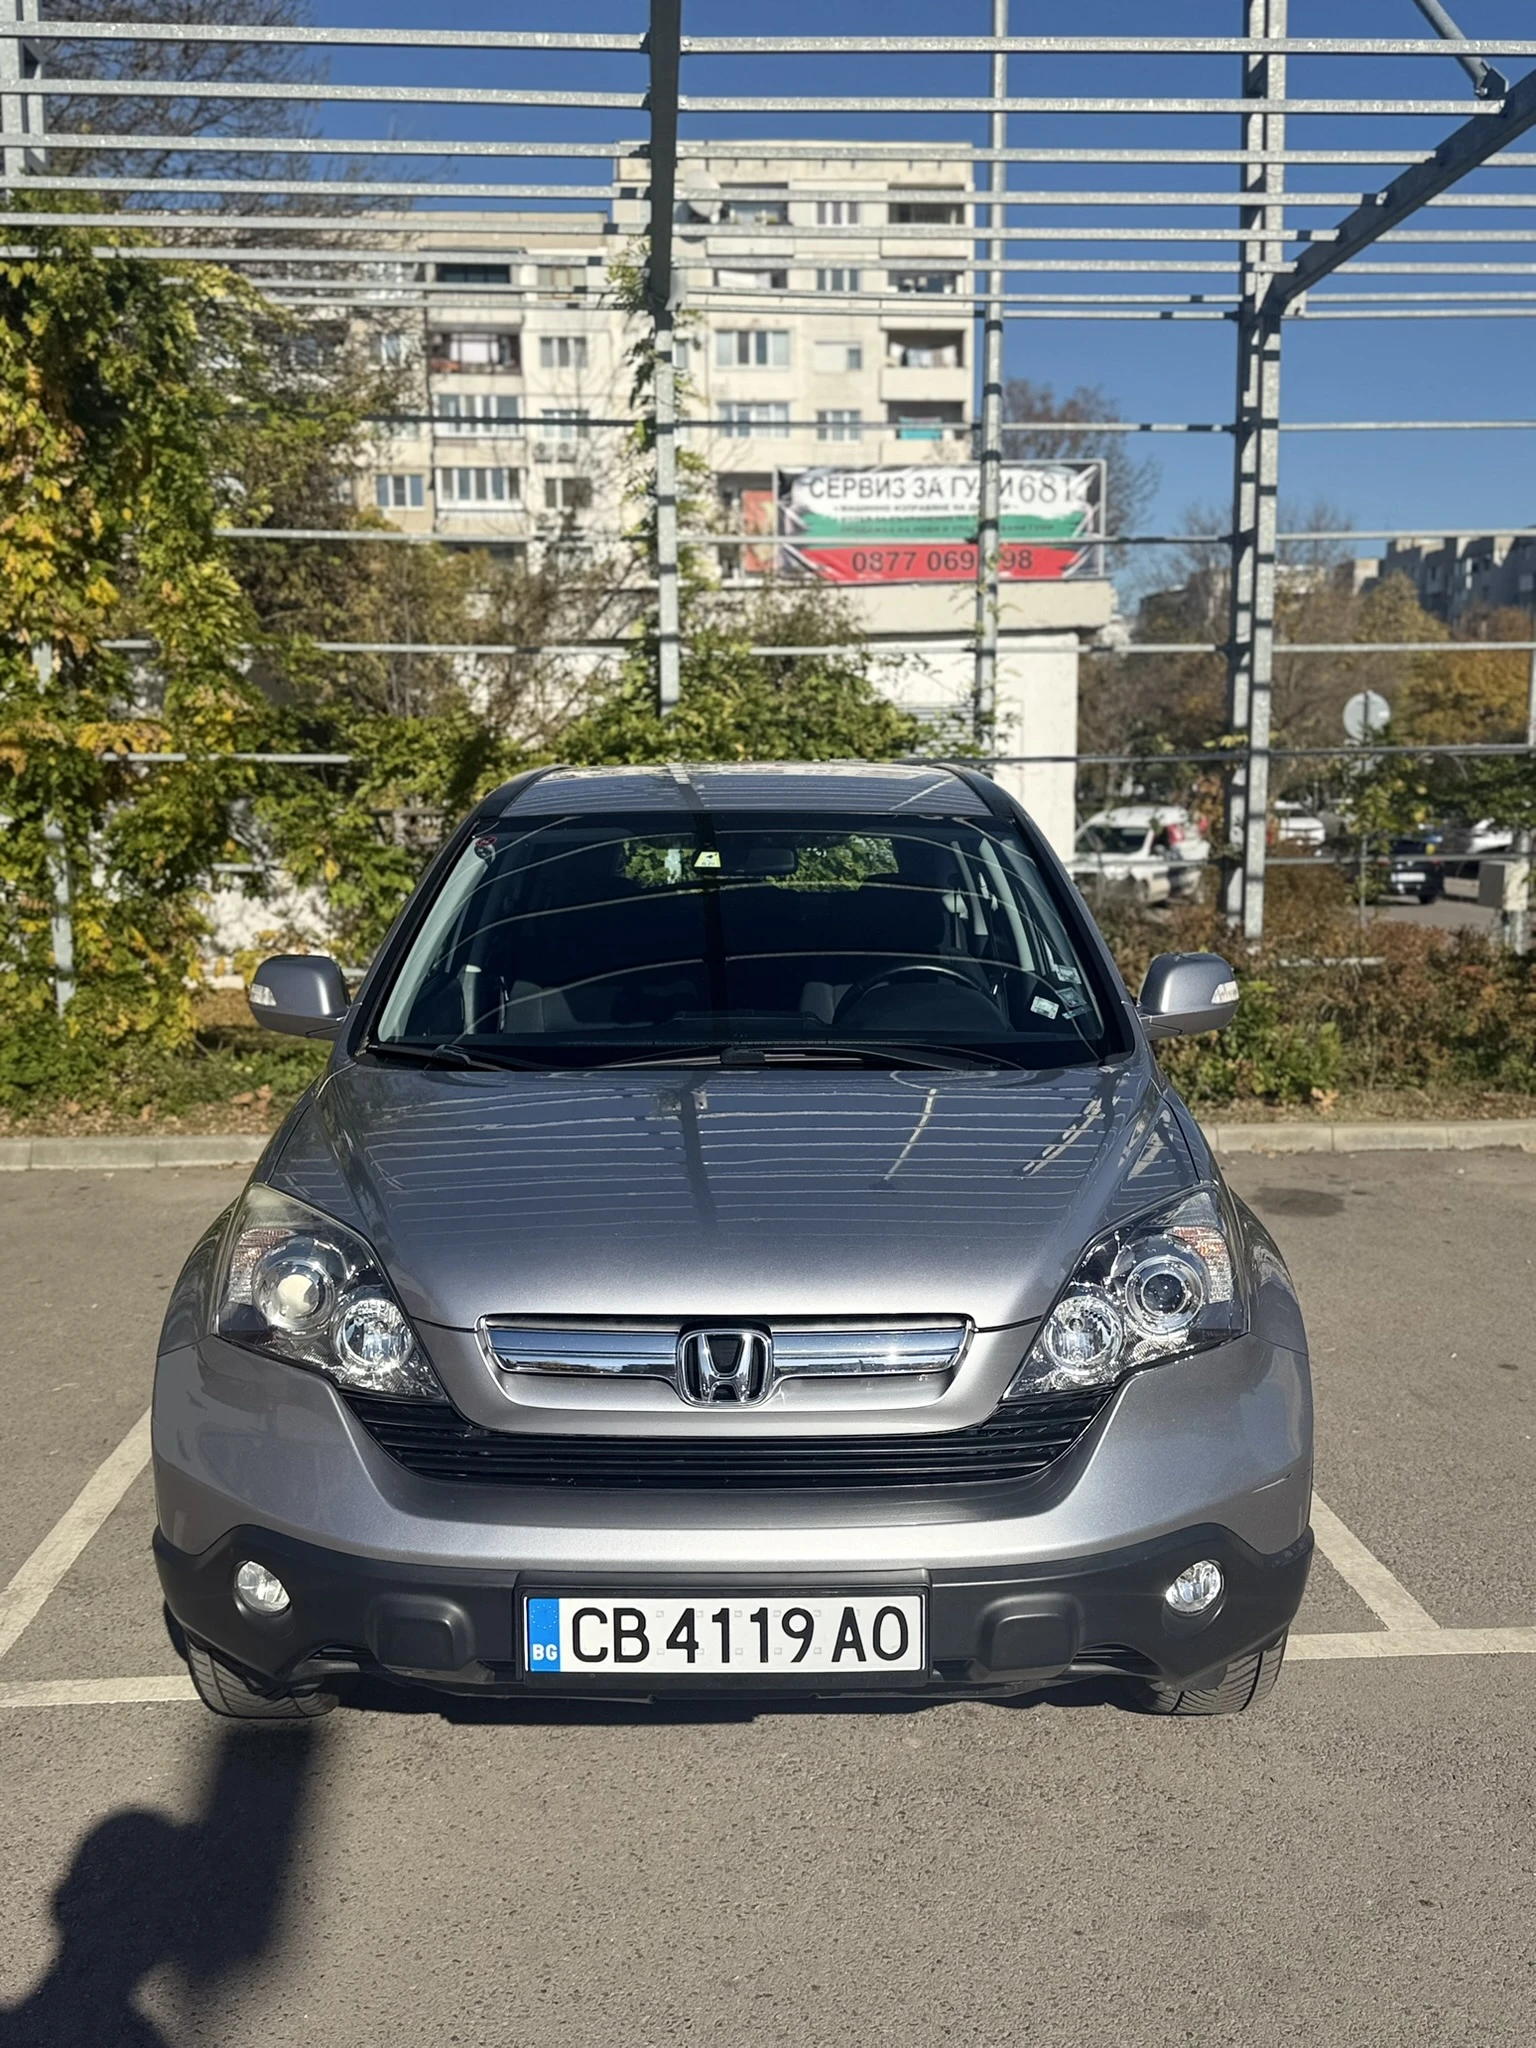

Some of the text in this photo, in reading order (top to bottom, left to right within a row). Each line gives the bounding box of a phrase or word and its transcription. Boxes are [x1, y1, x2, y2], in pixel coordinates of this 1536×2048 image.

[809, 476, 906, 499] СЕРВИЗ
[912, 476, 943, 498] ЗА
[951, 475, 1013, 498] ГУИ
[851, 551, 917, 573] 0877
[571, 1606, 650, 1664] CB
[665, 1606, 815, 1664] 4119
[531, 1644, 558, 1661] BG
